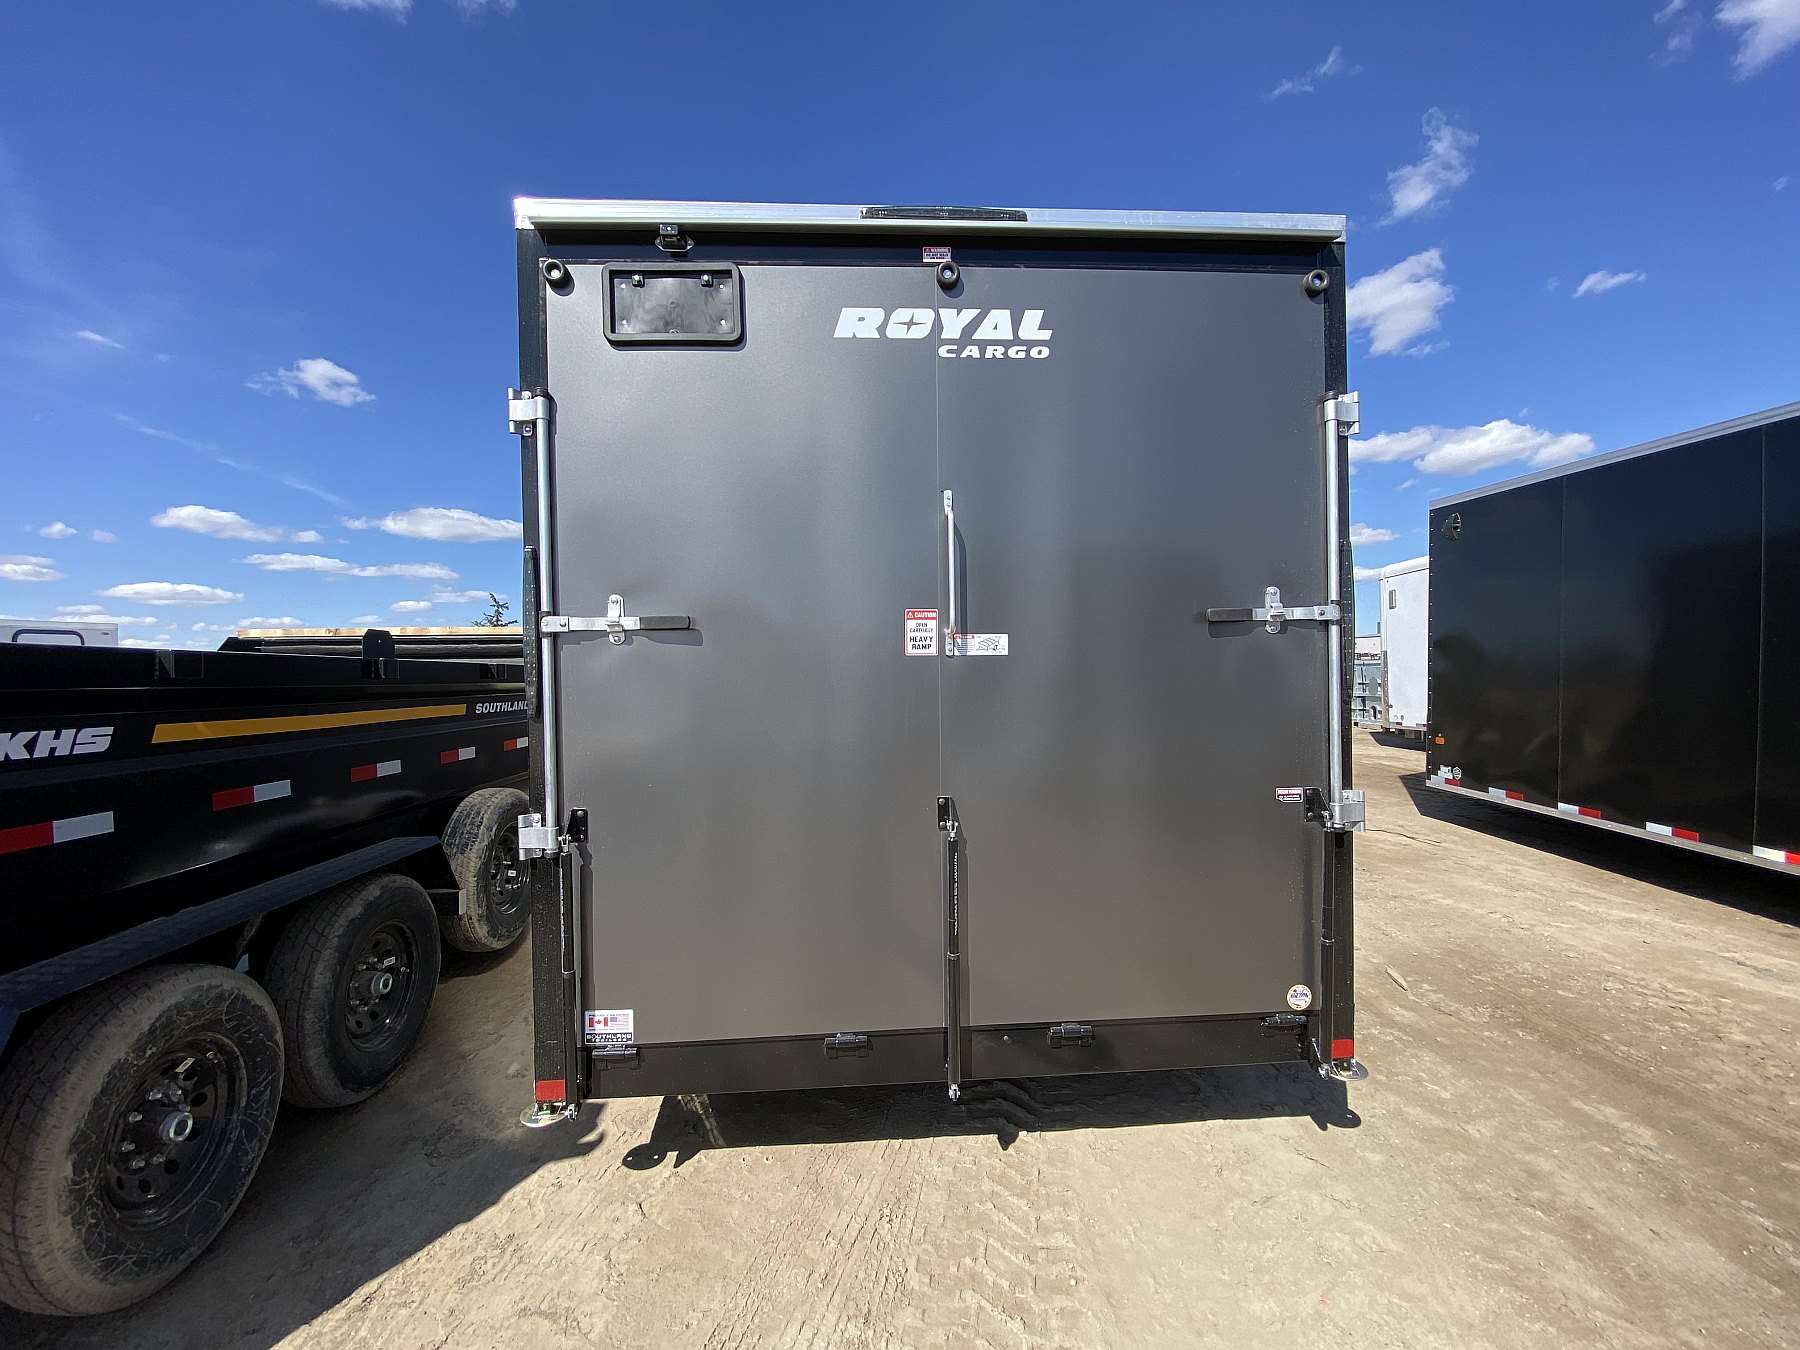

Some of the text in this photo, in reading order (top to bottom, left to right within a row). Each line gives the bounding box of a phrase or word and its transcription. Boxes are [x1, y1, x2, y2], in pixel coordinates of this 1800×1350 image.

[833, 307, 1053, 340] ROYAL
[938, 345, 1050, 359] CARGO
[909, 635, 934, 643] HEAVY
